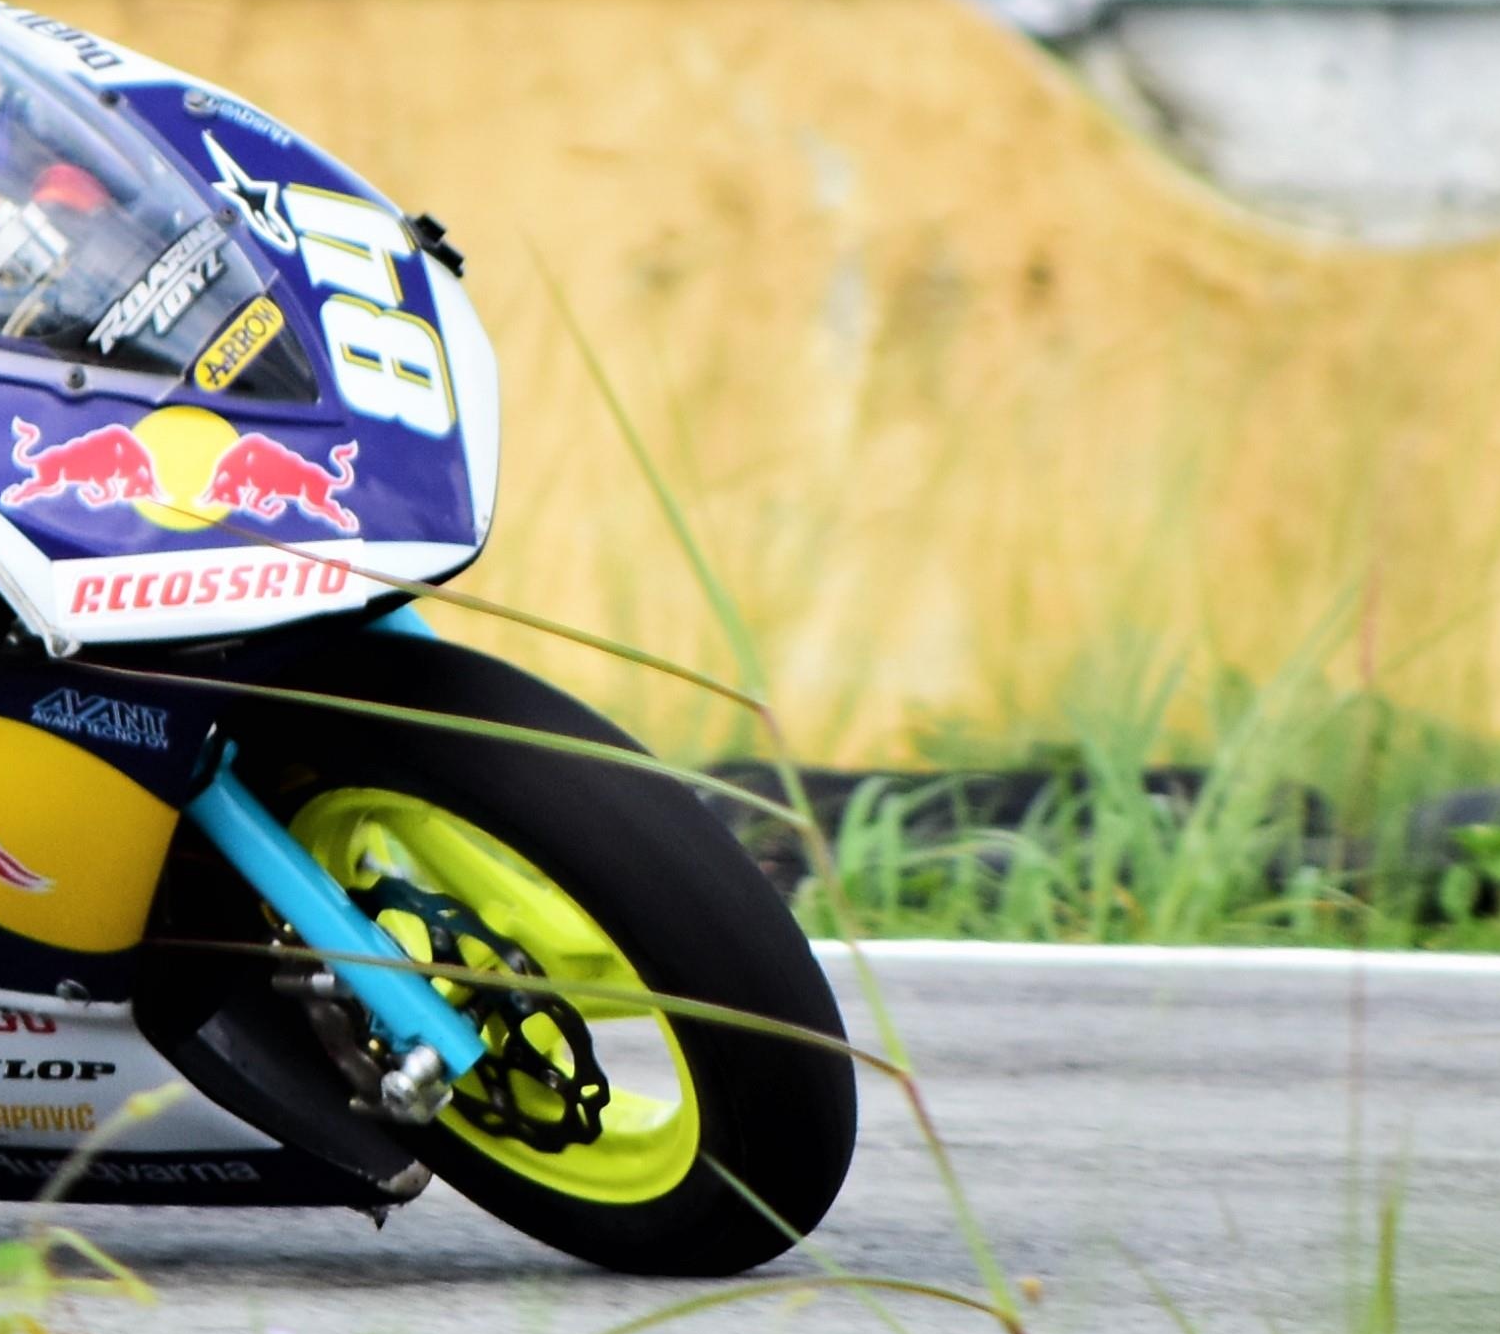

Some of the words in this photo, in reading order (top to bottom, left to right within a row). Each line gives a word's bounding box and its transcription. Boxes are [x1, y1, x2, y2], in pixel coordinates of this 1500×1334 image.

[87, 216, 227, 355] ROARING
[281, 182, 456, 438] 84
[70, 559, 351, 614] ACCOSSATO
[31, 687, 168, 739] AVANT
[31, 710, 82, 733] AVANT
[86, 720, 142, 746] TECNO
